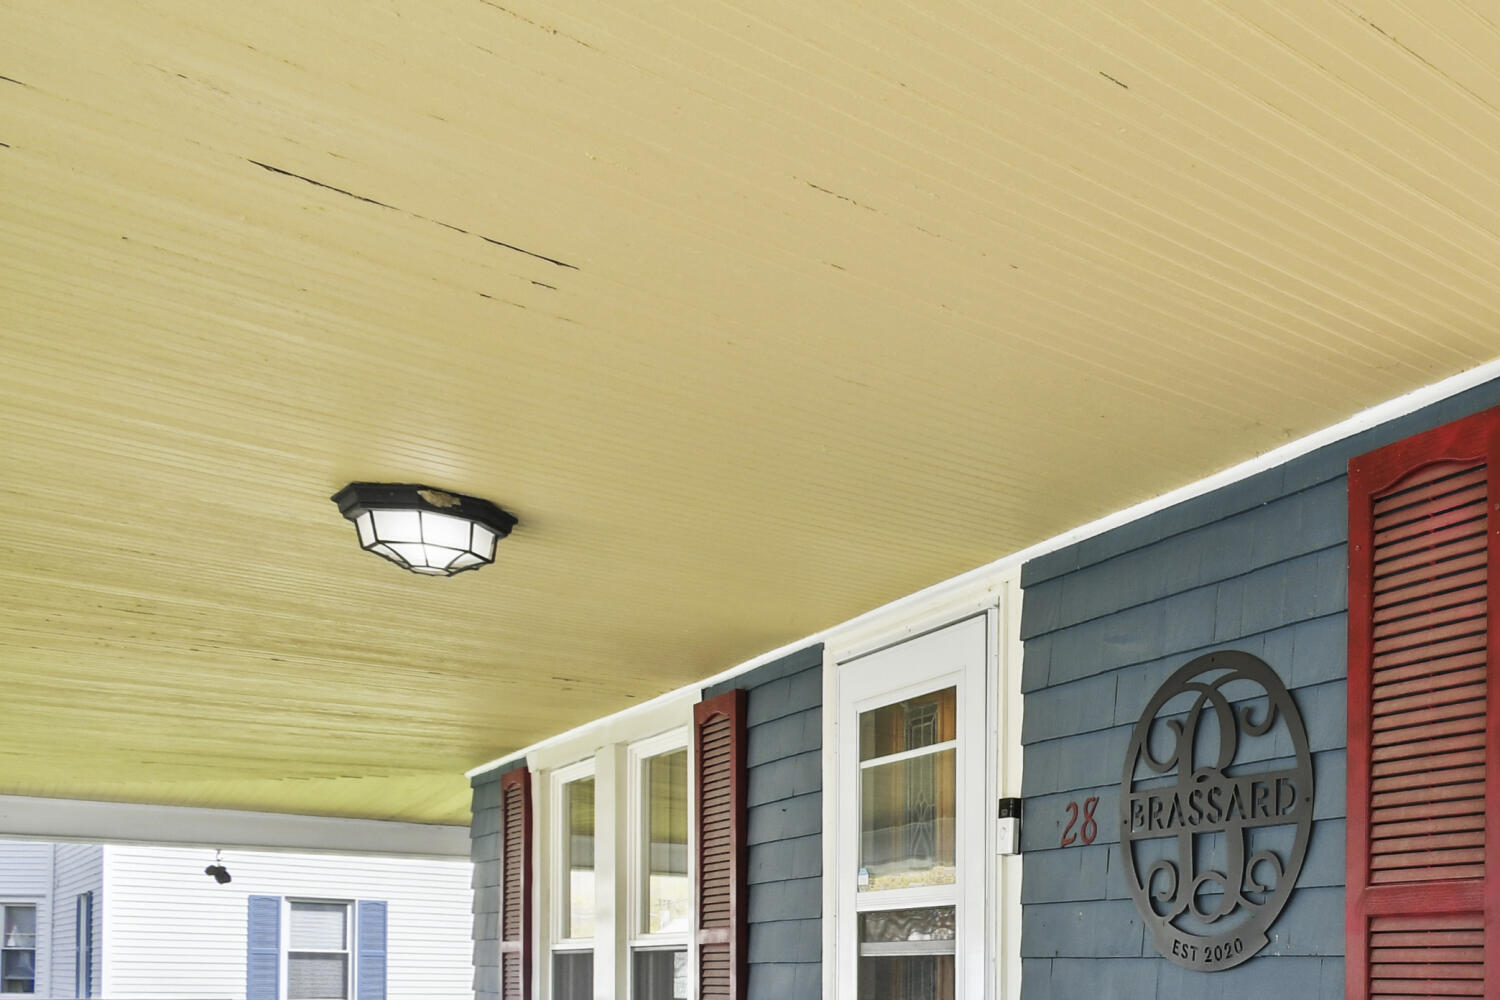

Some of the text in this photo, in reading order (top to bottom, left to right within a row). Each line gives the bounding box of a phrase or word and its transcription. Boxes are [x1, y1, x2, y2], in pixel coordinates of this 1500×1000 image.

[1061, 796, 1100, 848] 28
[1130, 777, 1297, 833] BRASSARD
[1172, 937, 1243, 962] EST 2020
